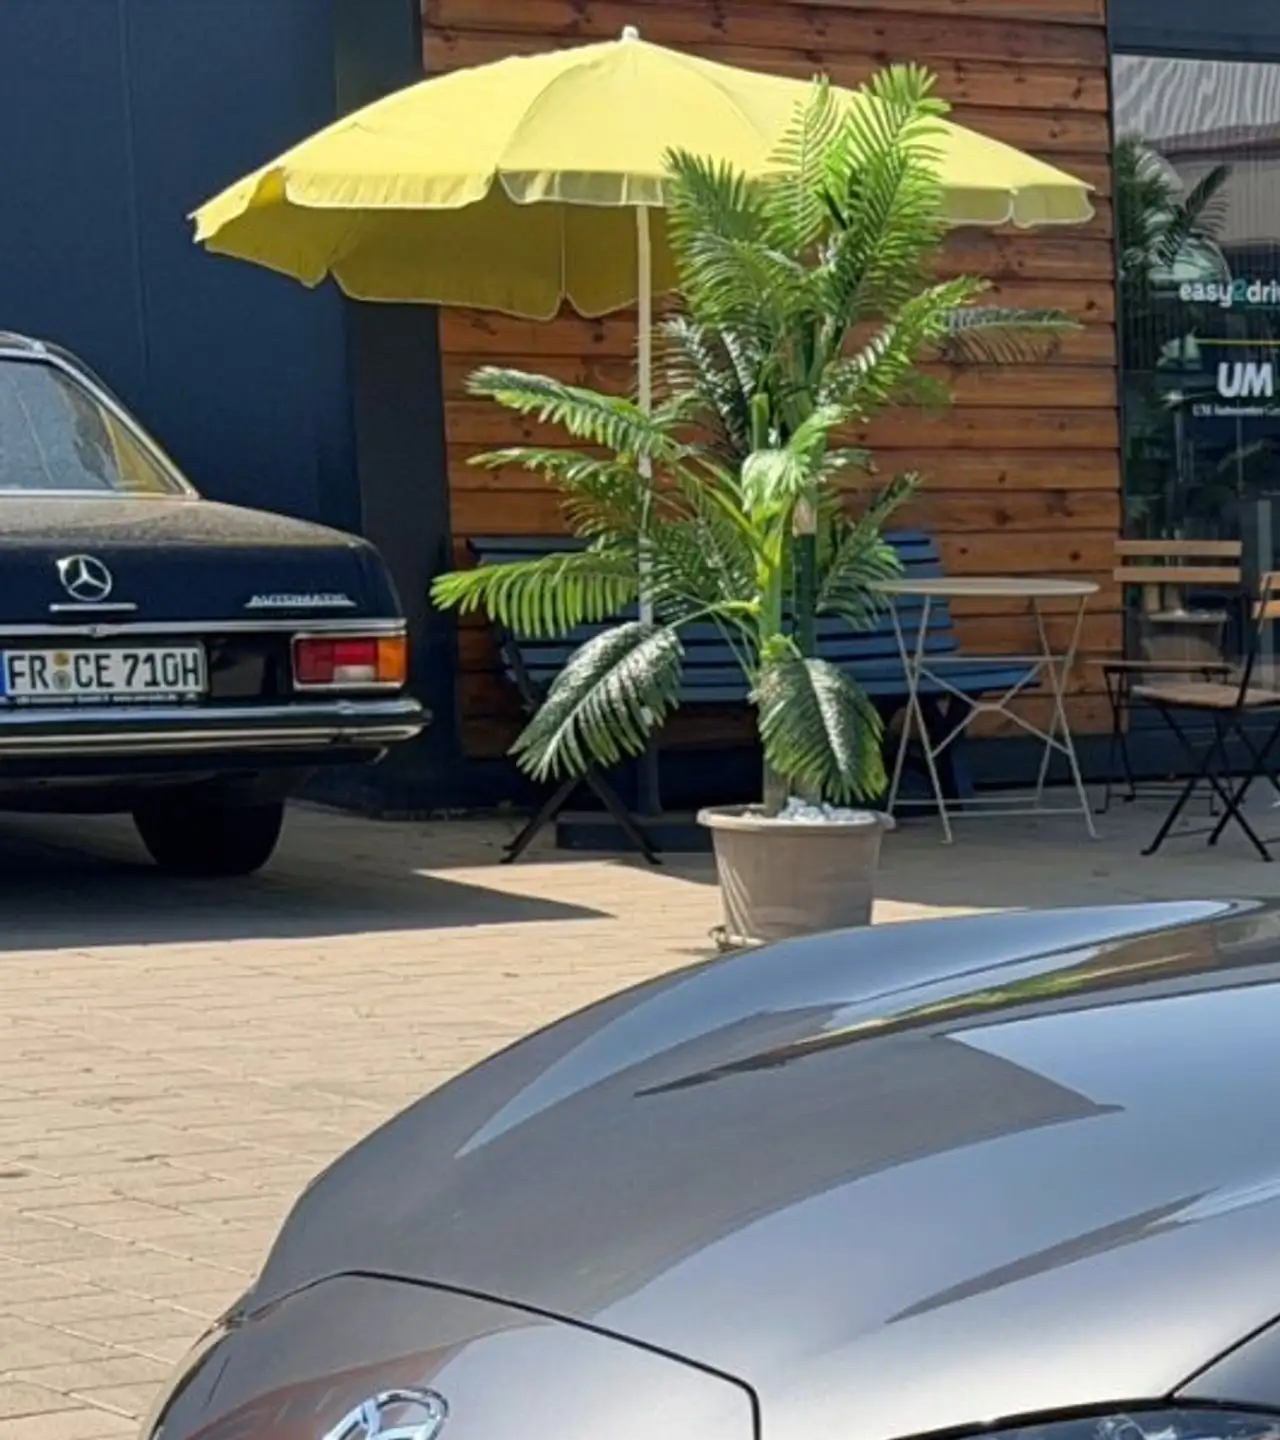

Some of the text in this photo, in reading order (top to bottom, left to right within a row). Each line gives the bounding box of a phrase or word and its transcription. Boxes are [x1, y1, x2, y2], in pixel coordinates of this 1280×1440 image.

[1217, 361, 1273, 398] UM
[8, 652, 200, 689] FR CE 710H
